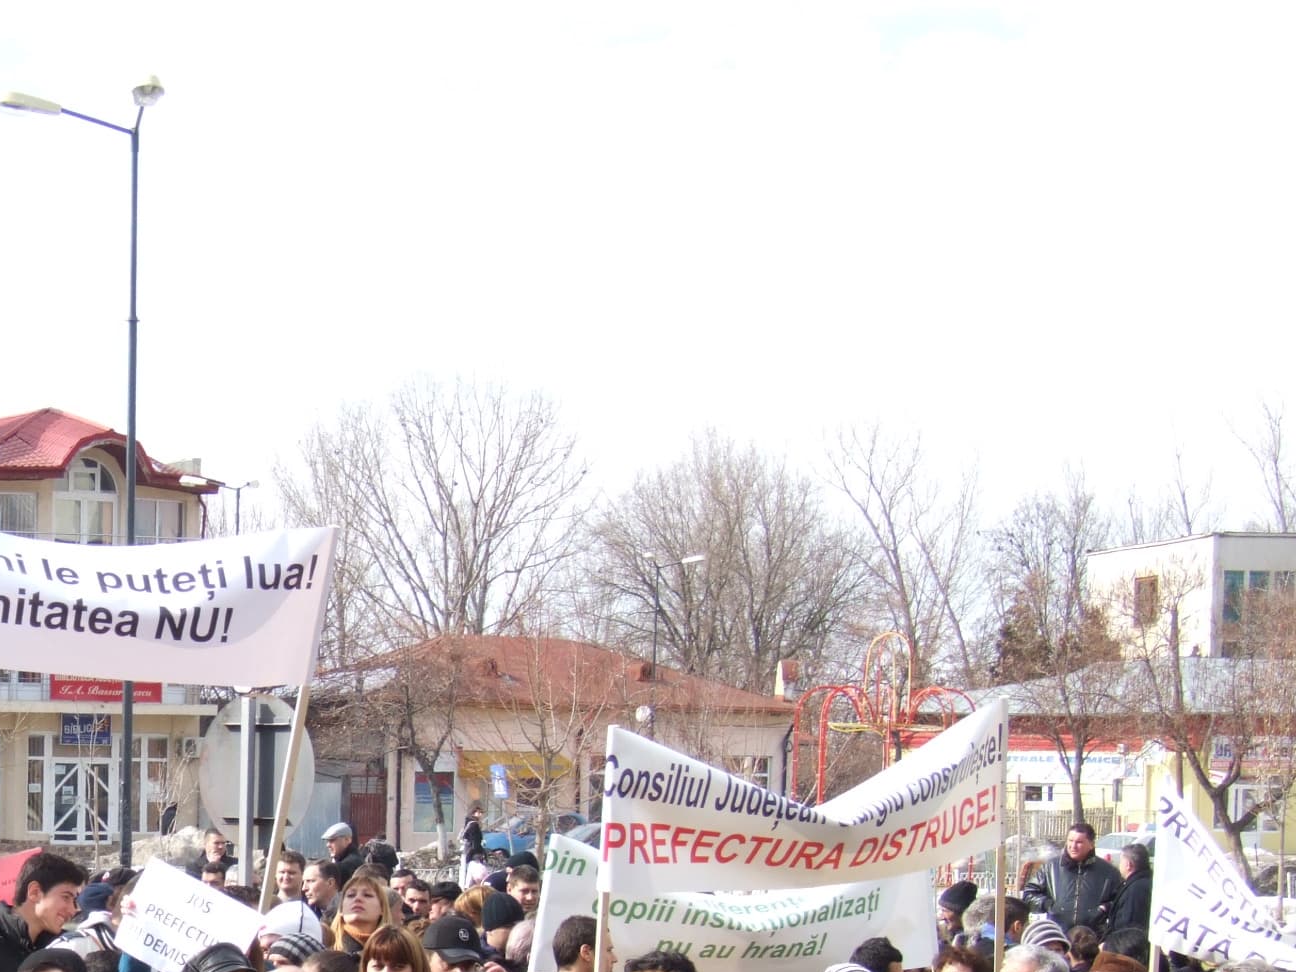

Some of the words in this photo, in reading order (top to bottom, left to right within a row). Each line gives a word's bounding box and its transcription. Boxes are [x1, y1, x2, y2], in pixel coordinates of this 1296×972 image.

[41, 558, 80, 586] le
[96, 560, 227, 601] puteți
[243, 554, 318, 590] lua!
[154, 606, 234, 643] NU!
[604, 754, 712, 809] Consiliul
[603, 822, 844, 871] PREFECTURA
[849, 785, 997, 868] DISTRUGE!
[542, 848, 586, 876] Din
[143, 933, 188, 966] DEMIS
[699, 943, 735, 960] au
[741, 932, 827, 960] hrană!
